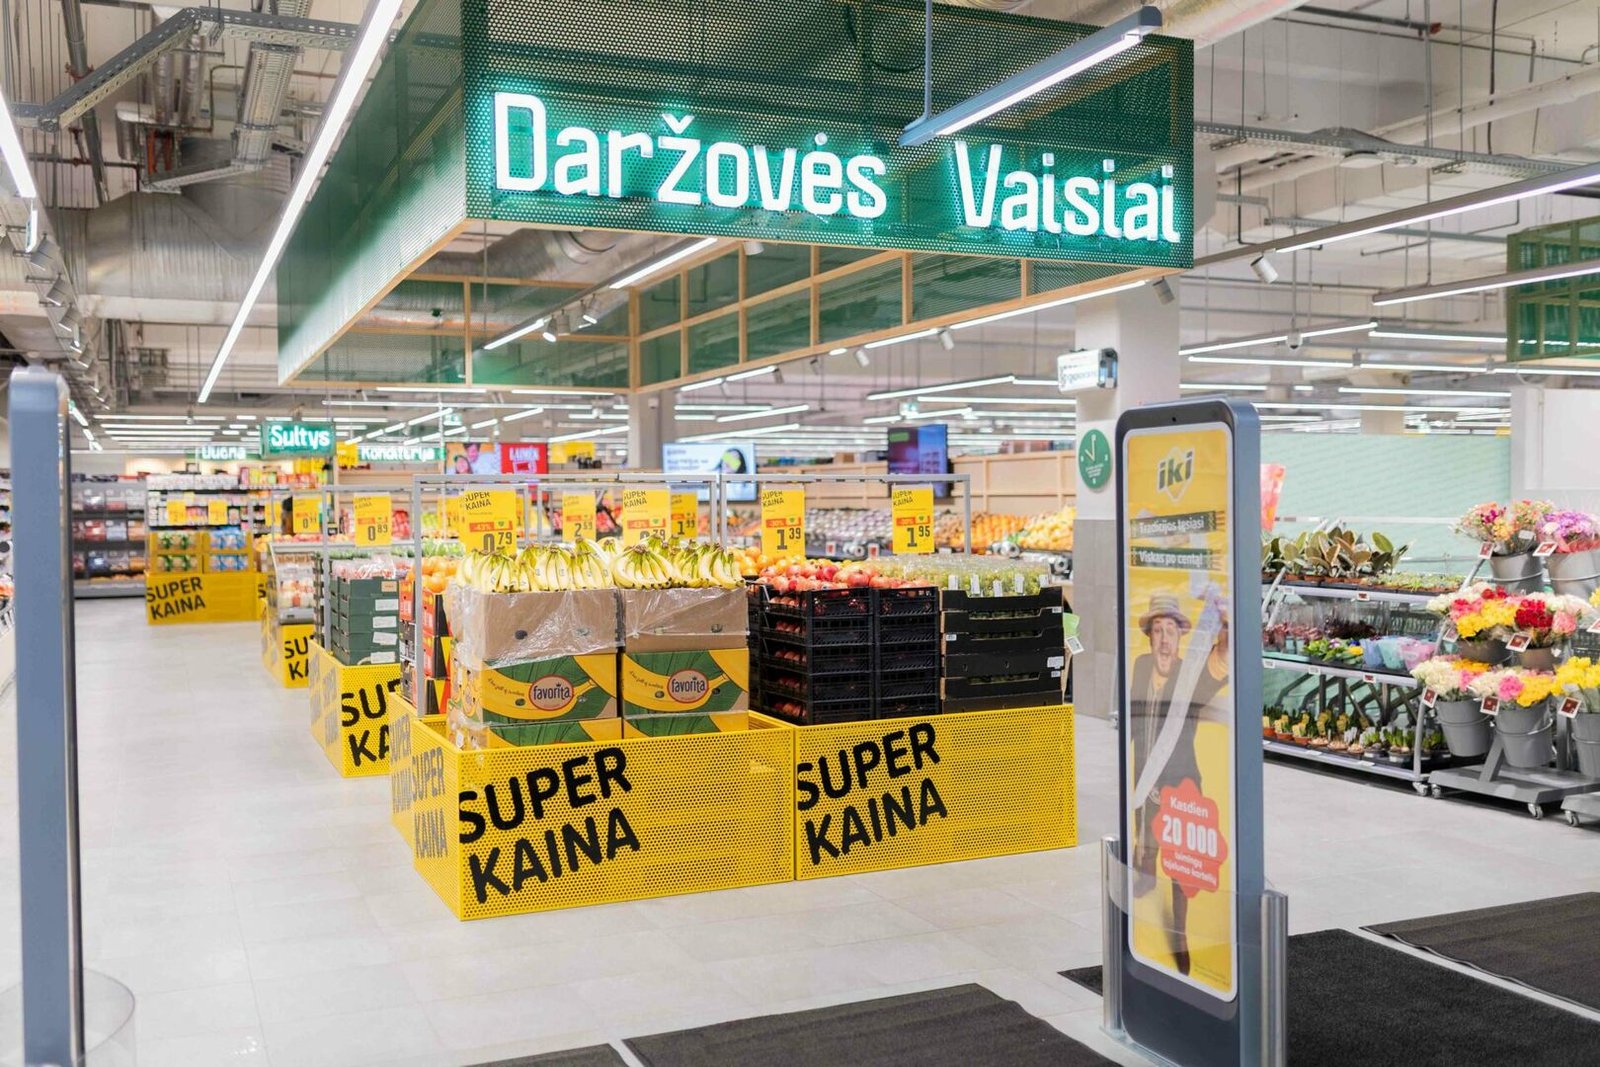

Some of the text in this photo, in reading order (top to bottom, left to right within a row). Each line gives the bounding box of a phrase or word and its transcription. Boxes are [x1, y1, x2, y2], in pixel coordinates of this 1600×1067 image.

[493, 91, 1180, 243] Daržovės Vaisiai
[271, 425, 330, 450] Sultys
[1159, 451, 1193, 490] iki
[466, 499, 491, 510] KAINA
[624, 498, 647, 508] KAINA
[146, 576, 203, 602] SUPER
[151, 595, 206, 620] KAINA
[533, 682, 570, 701] favorita
[672, 677, 706, 694] favorita
[797, 722, 940, 811] SUPER
[459, 747, 632, 843] SUPER
[1170, 796, 1209, 818] Kasdien
[805, 777, 947, 865] KAINA
[1162, 814, 1217, 858] 20 000
[468, 807, 641, 903] KAINA
